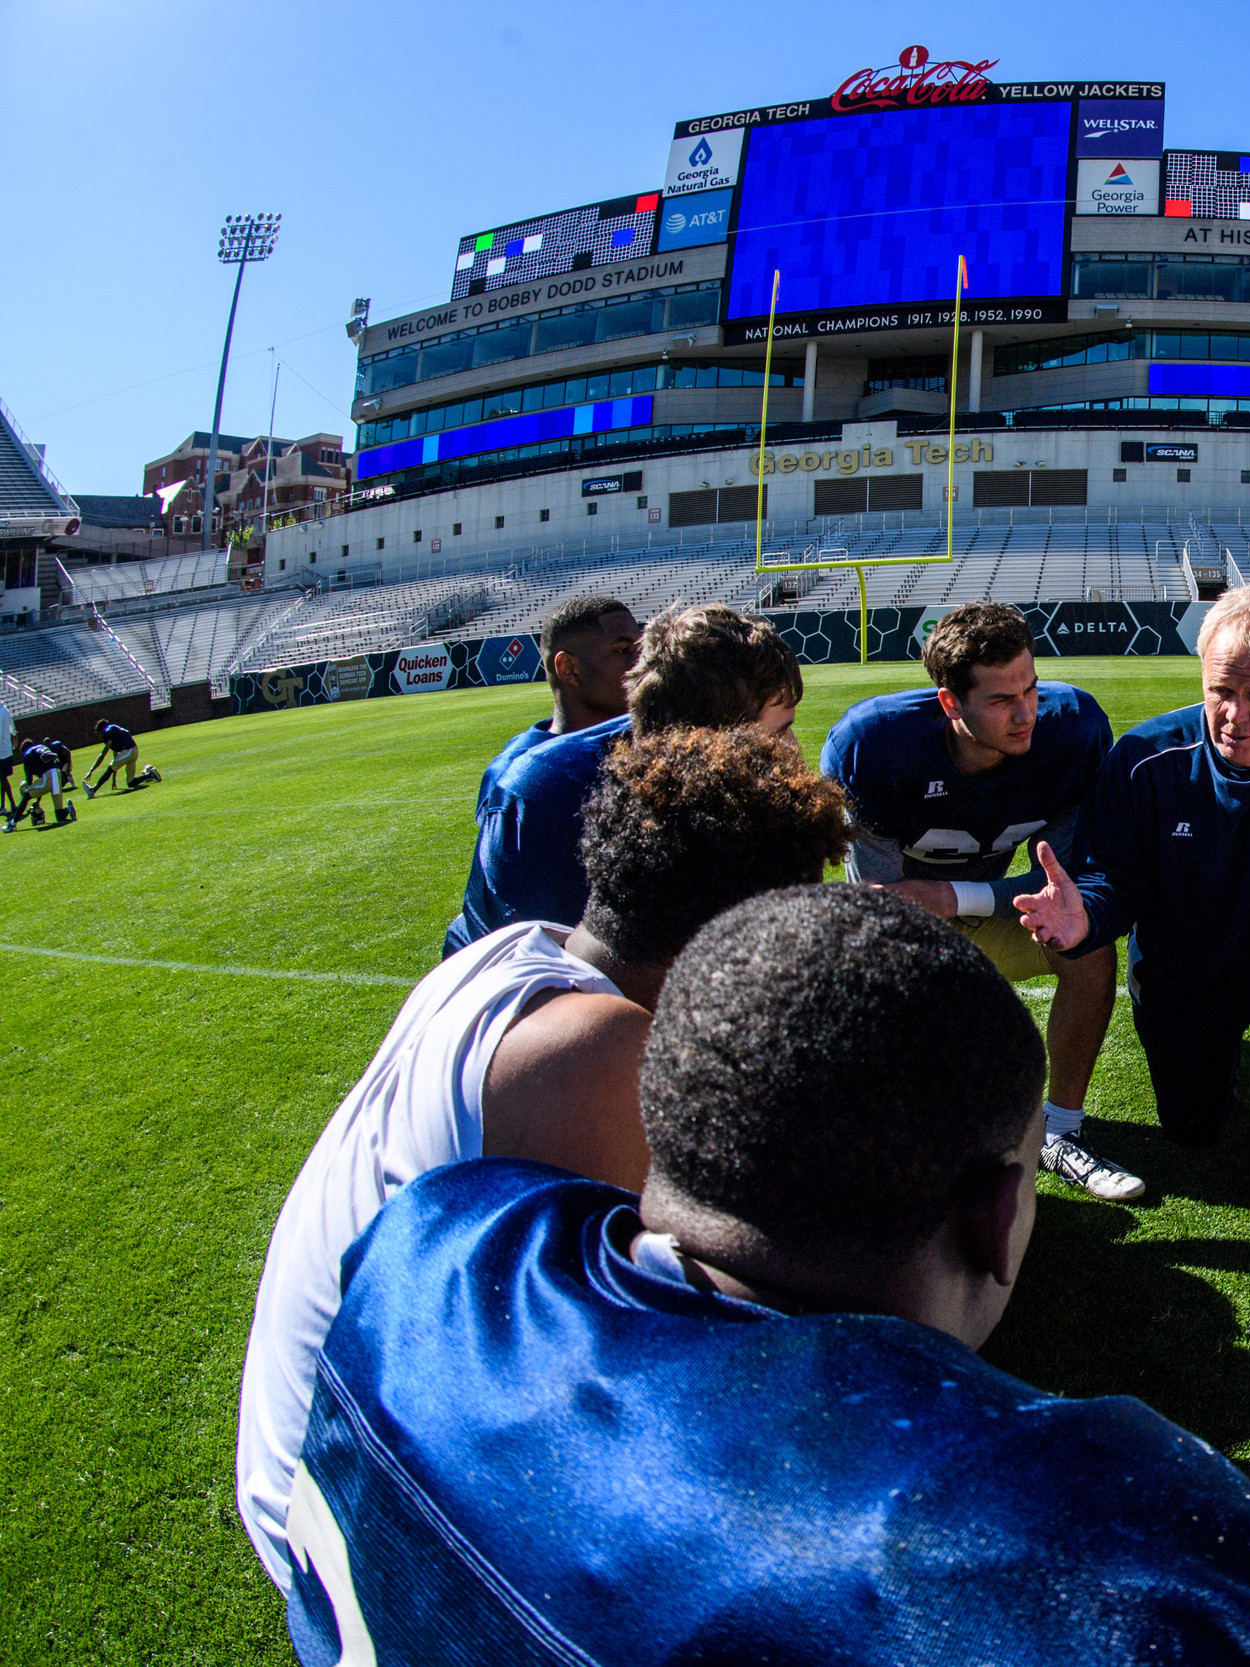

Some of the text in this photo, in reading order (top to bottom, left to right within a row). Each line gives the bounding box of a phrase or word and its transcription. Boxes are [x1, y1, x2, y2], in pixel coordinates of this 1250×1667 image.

[999, 84, 1163, 98] YELLOW JACKETS
[688, 103, 810, 133] GEORGIA TECH
[1083, 119, 1158, 131] WELLSTAR
[677, 166, 719, 182] Georgia
[667, 175, 731, 195] Natural Gas
[1091, 189, 1144, 203] Georgia
[1097, 202, 1139, 213] Power
[688, 209, 727, 228] AT&T
[1184, 227, 1212, 243] AT
[387, 260, 684, 341] WELCOME TO BOBBY DODD STADIUM
[745, 322, 809, 340] NATONAL
[817, 314, 899, 332] CHAMPIONS
[1011, 308, 1042, 320] 1990
[749, 438, 994, 475] Georgia Tech
[589, 481, 620, 490] SCANA
[1074, 621, 1128, 633] DELTA
[398, 655, 448, 673] Quicken
[406, 671, 443, 686] Loans
[495, 671, 530, 682] Domino's
